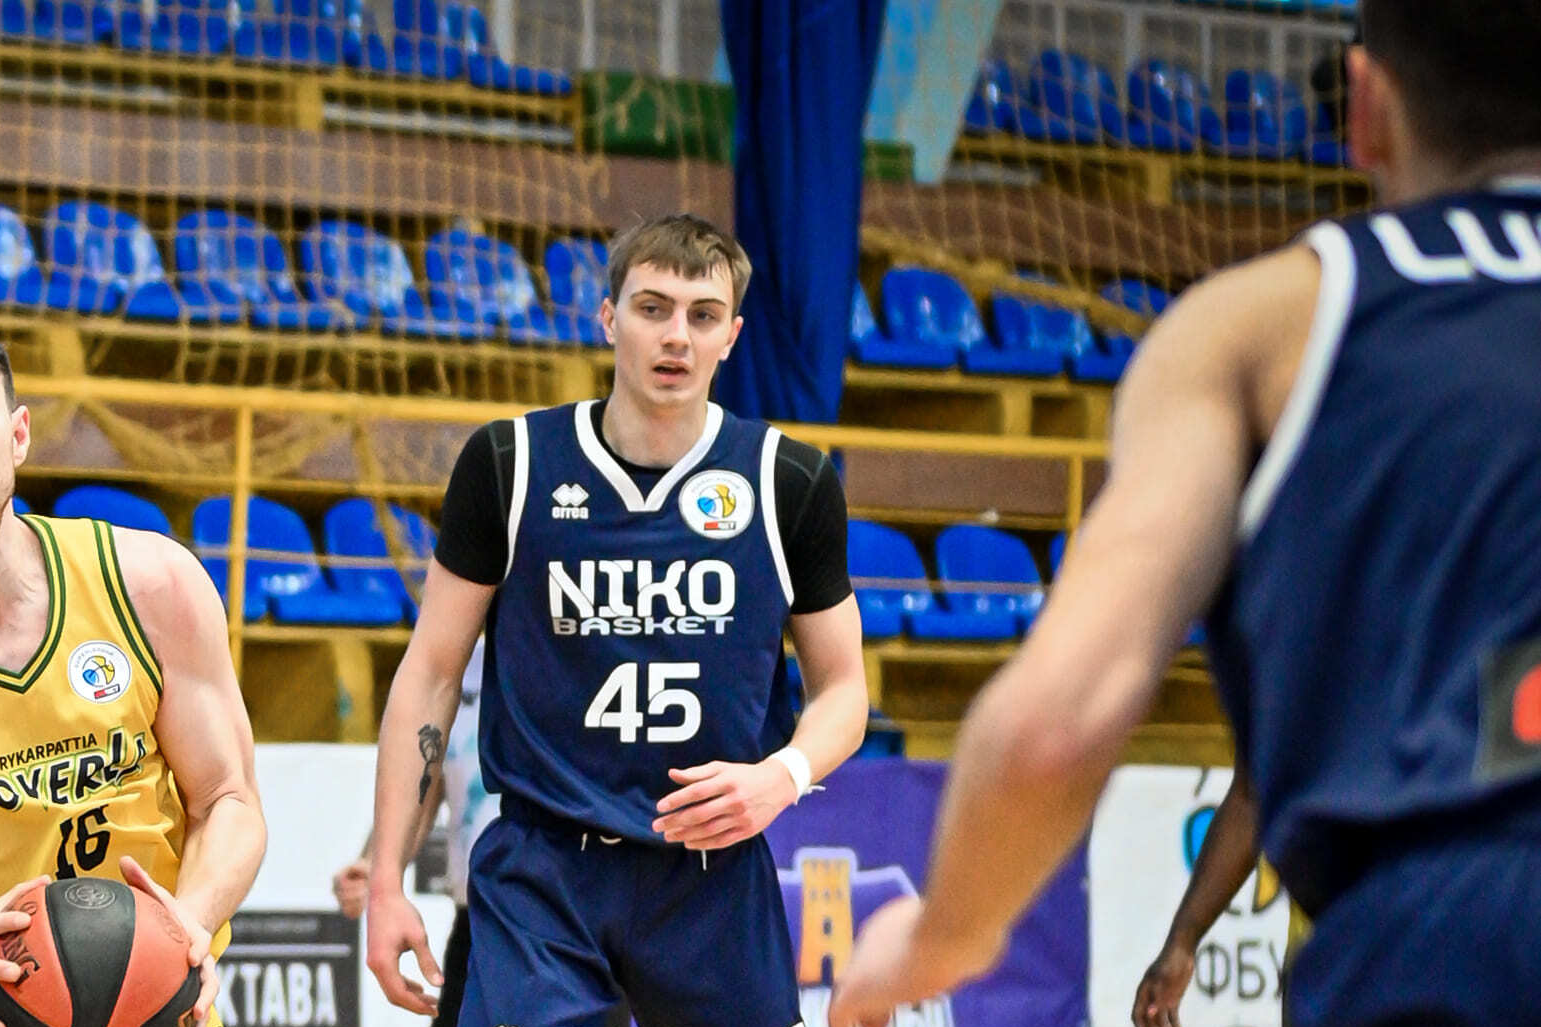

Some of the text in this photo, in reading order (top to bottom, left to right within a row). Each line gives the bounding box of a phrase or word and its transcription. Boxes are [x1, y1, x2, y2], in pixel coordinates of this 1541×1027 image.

[1368, 208, 1541, 283] LU
[548, 559, 737, 618] NIKO
[553, 616, 735, 636] BASKET
[584, 662, 702, 743] 45
[55, 804, 111, 882] 16
